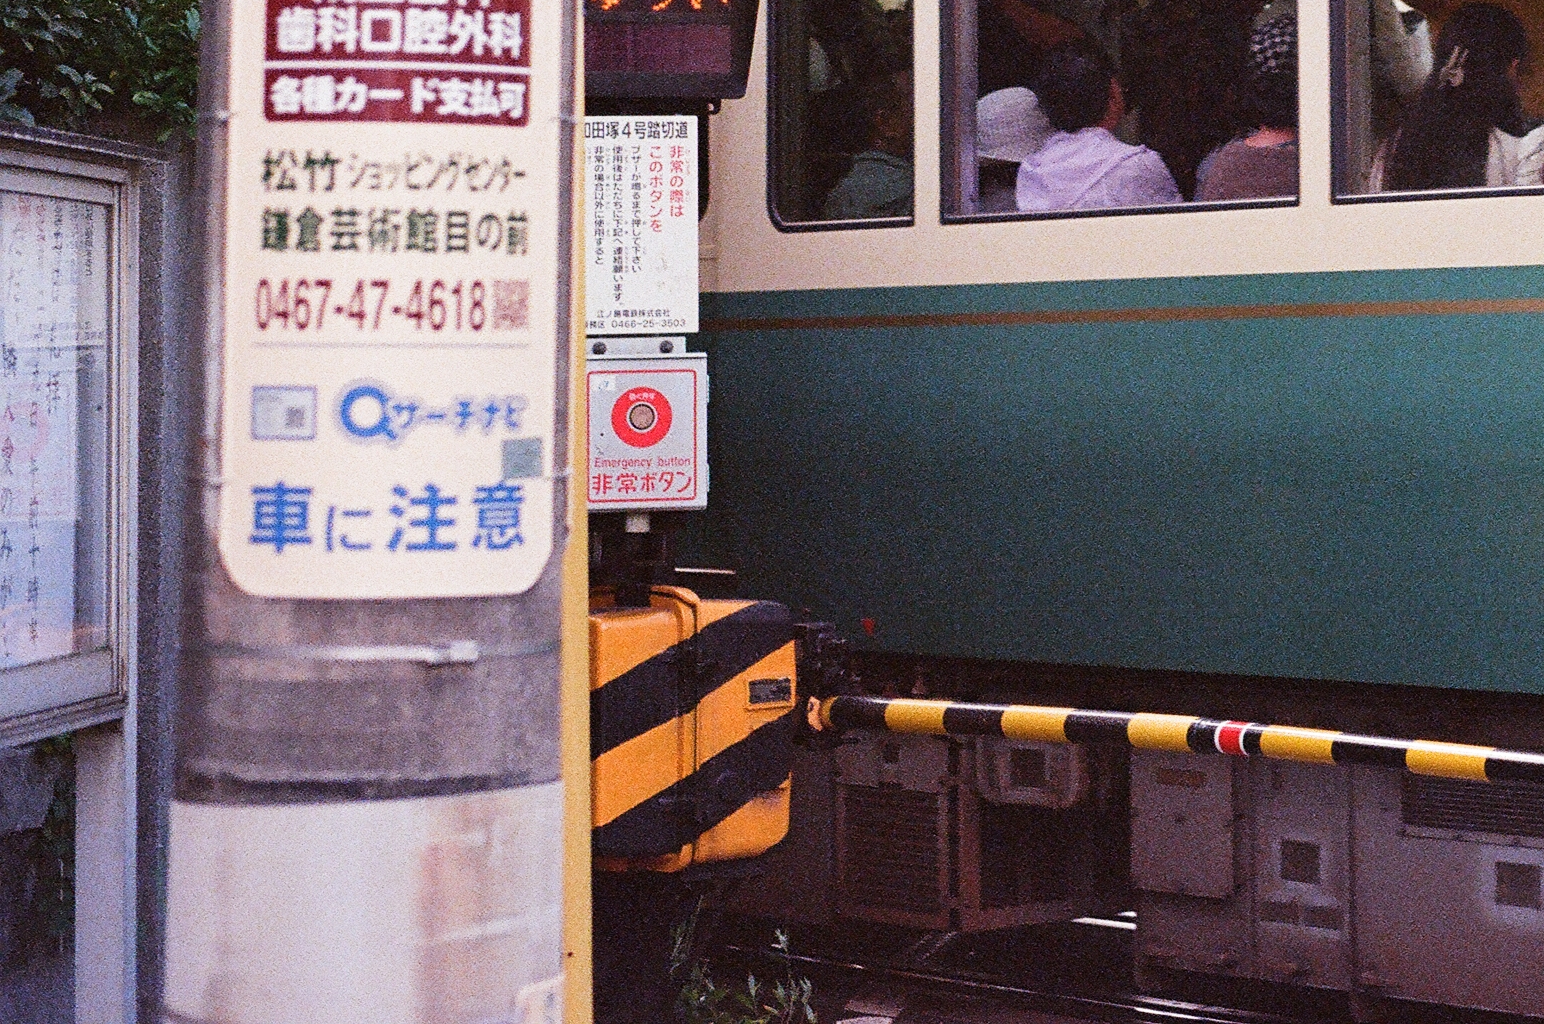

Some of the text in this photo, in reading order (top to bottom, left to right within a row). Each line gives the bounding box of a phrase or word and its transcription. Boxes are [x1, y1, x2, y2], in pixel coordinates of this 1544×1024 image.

[276, 6, 523, 59] 歯科口腔外科
[271, 75, 527, 119] 各種カード支払可
[261, 149, 528, 193] 松竹ショッピングセンター
[649, 145, 663, 233] このボタンを
[669, 145, 684, 217] 非常の際は
[255, 279, 487, 331] 0467-47-4618
[592, 471, 692, 494] 非常ボタン
[594, 456, 691, 470] Emergency button
[249, 480, 524, 554] 車に注意
